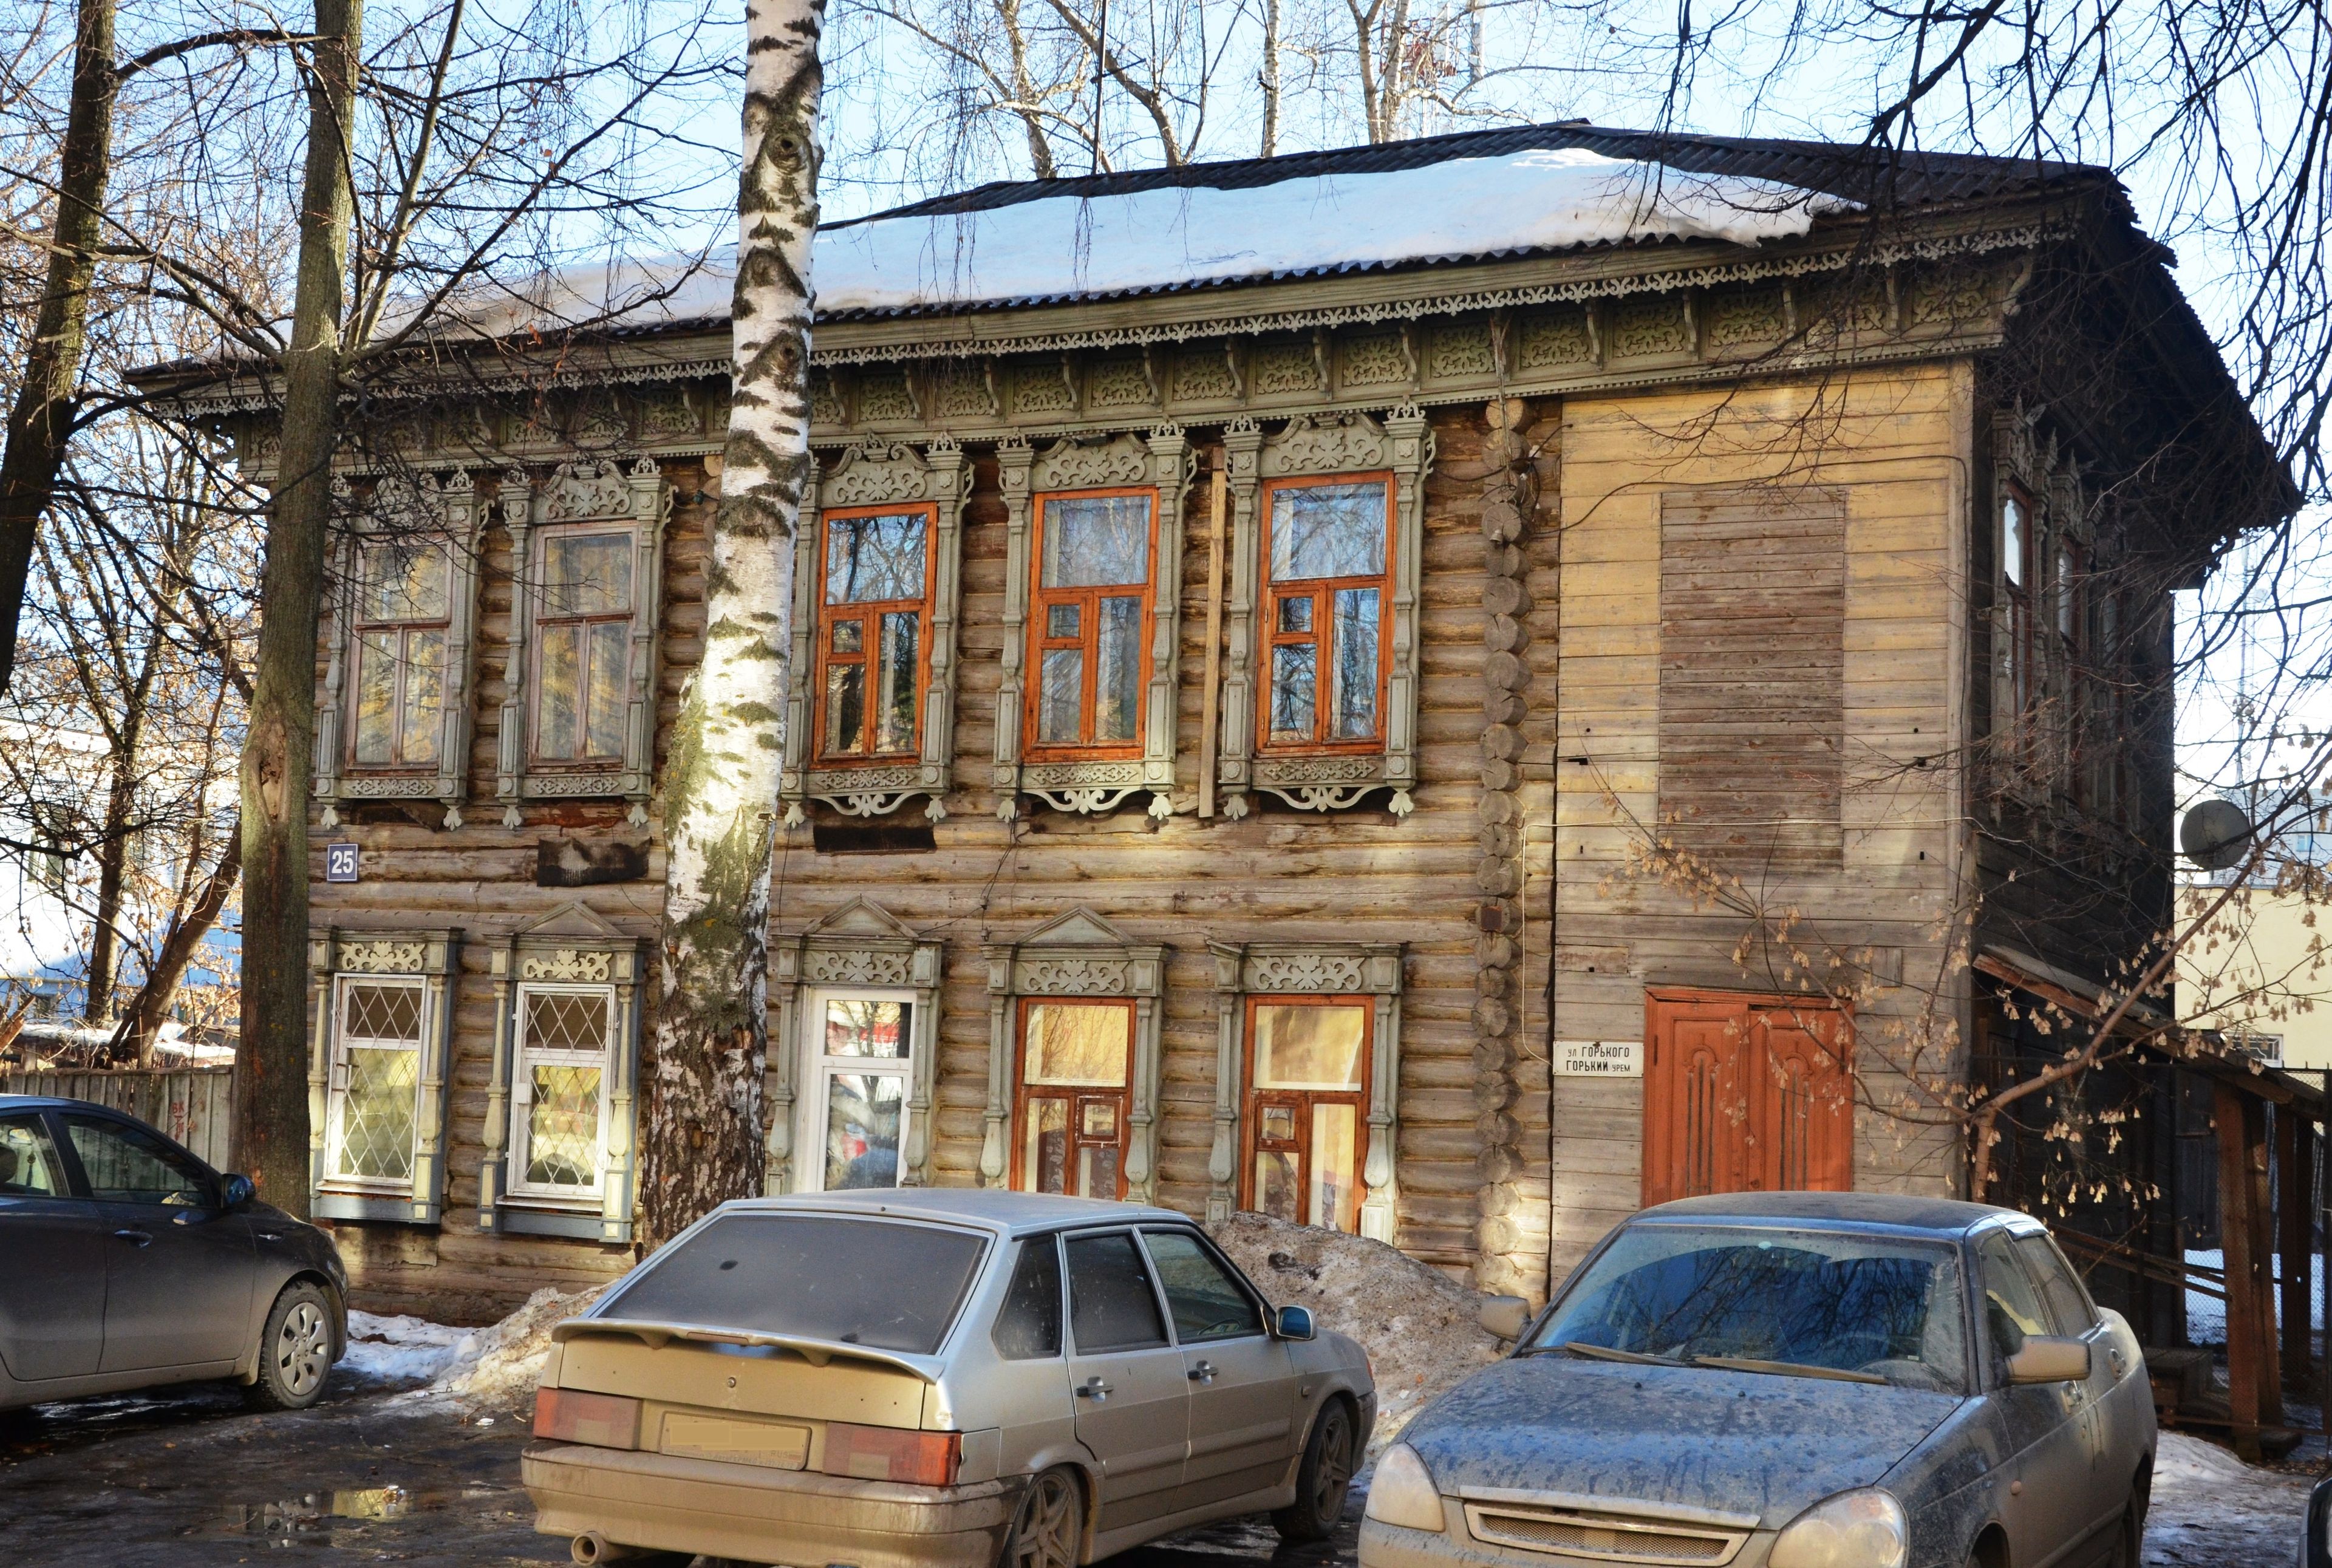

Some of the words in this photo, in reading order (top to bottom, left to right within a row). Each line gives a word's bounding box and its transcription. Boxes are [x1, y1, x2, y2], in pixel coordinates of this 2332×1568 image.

[332, 850, 353, 874] 25
[1567, 1049, 1577, 1057] УЛ
[1581, 1046, 1630, 1057] ГОРЬКОГО
[1566, 1058, 1609, 1072] ГОРЬКИЙ
